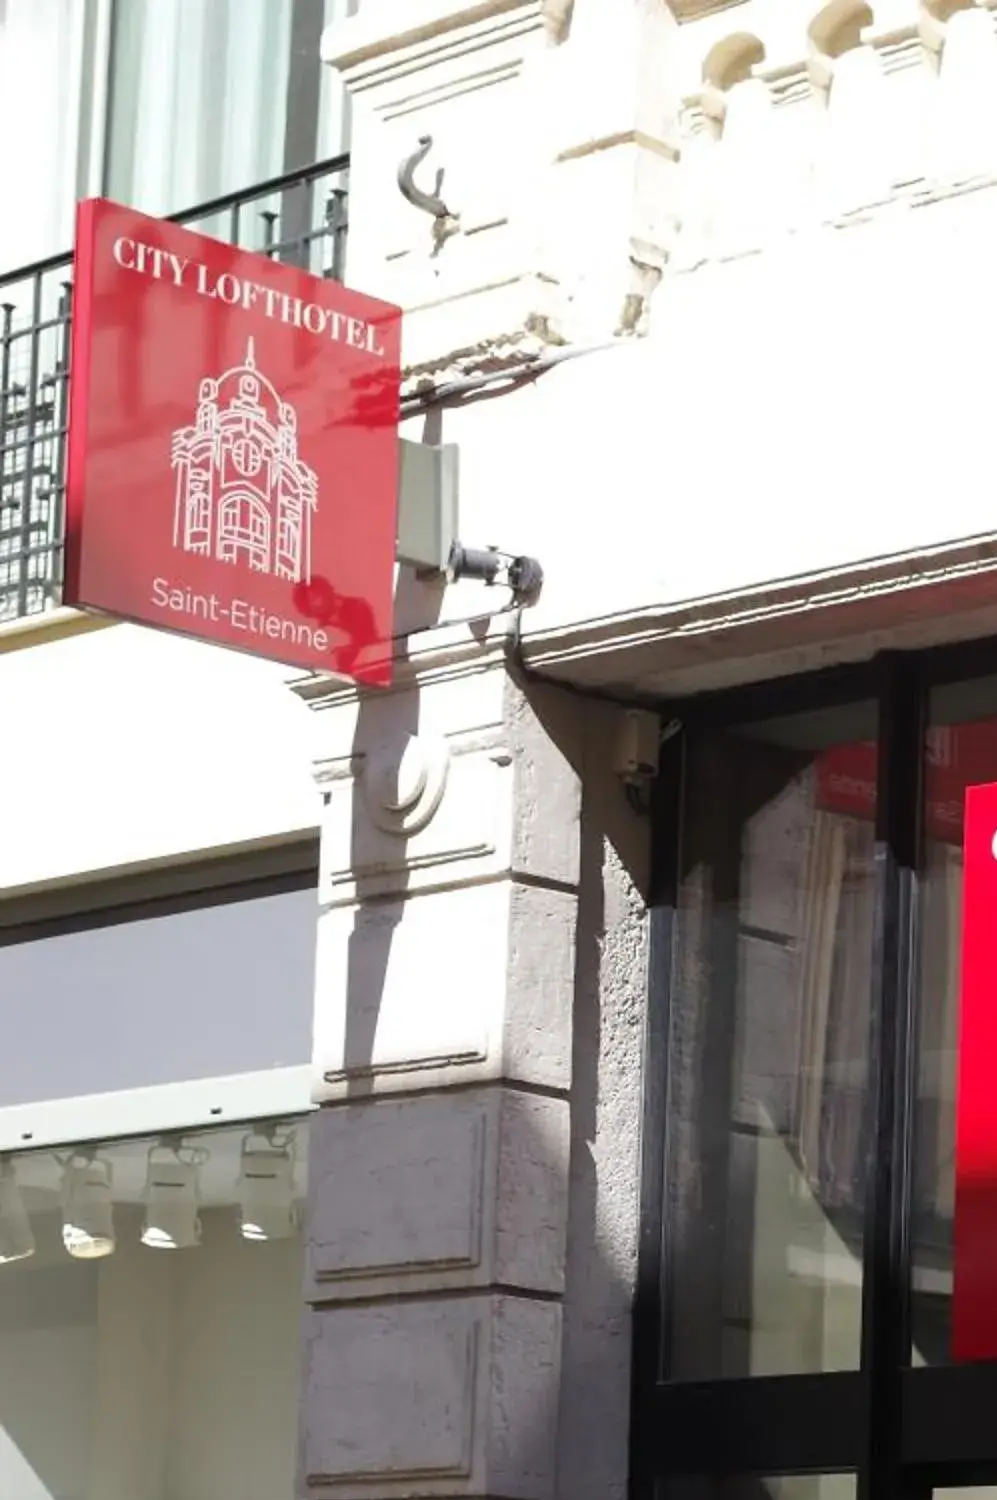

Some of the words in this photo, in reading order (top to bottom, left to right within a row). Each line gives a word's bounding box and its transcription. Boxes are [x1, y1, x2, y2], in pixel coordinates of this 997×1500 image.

[113, 236, 190, 287] CITY
[196, 265, 384, 356] LOFTHOTEL
[152, 577, 328, 651] Saint-Etienne
